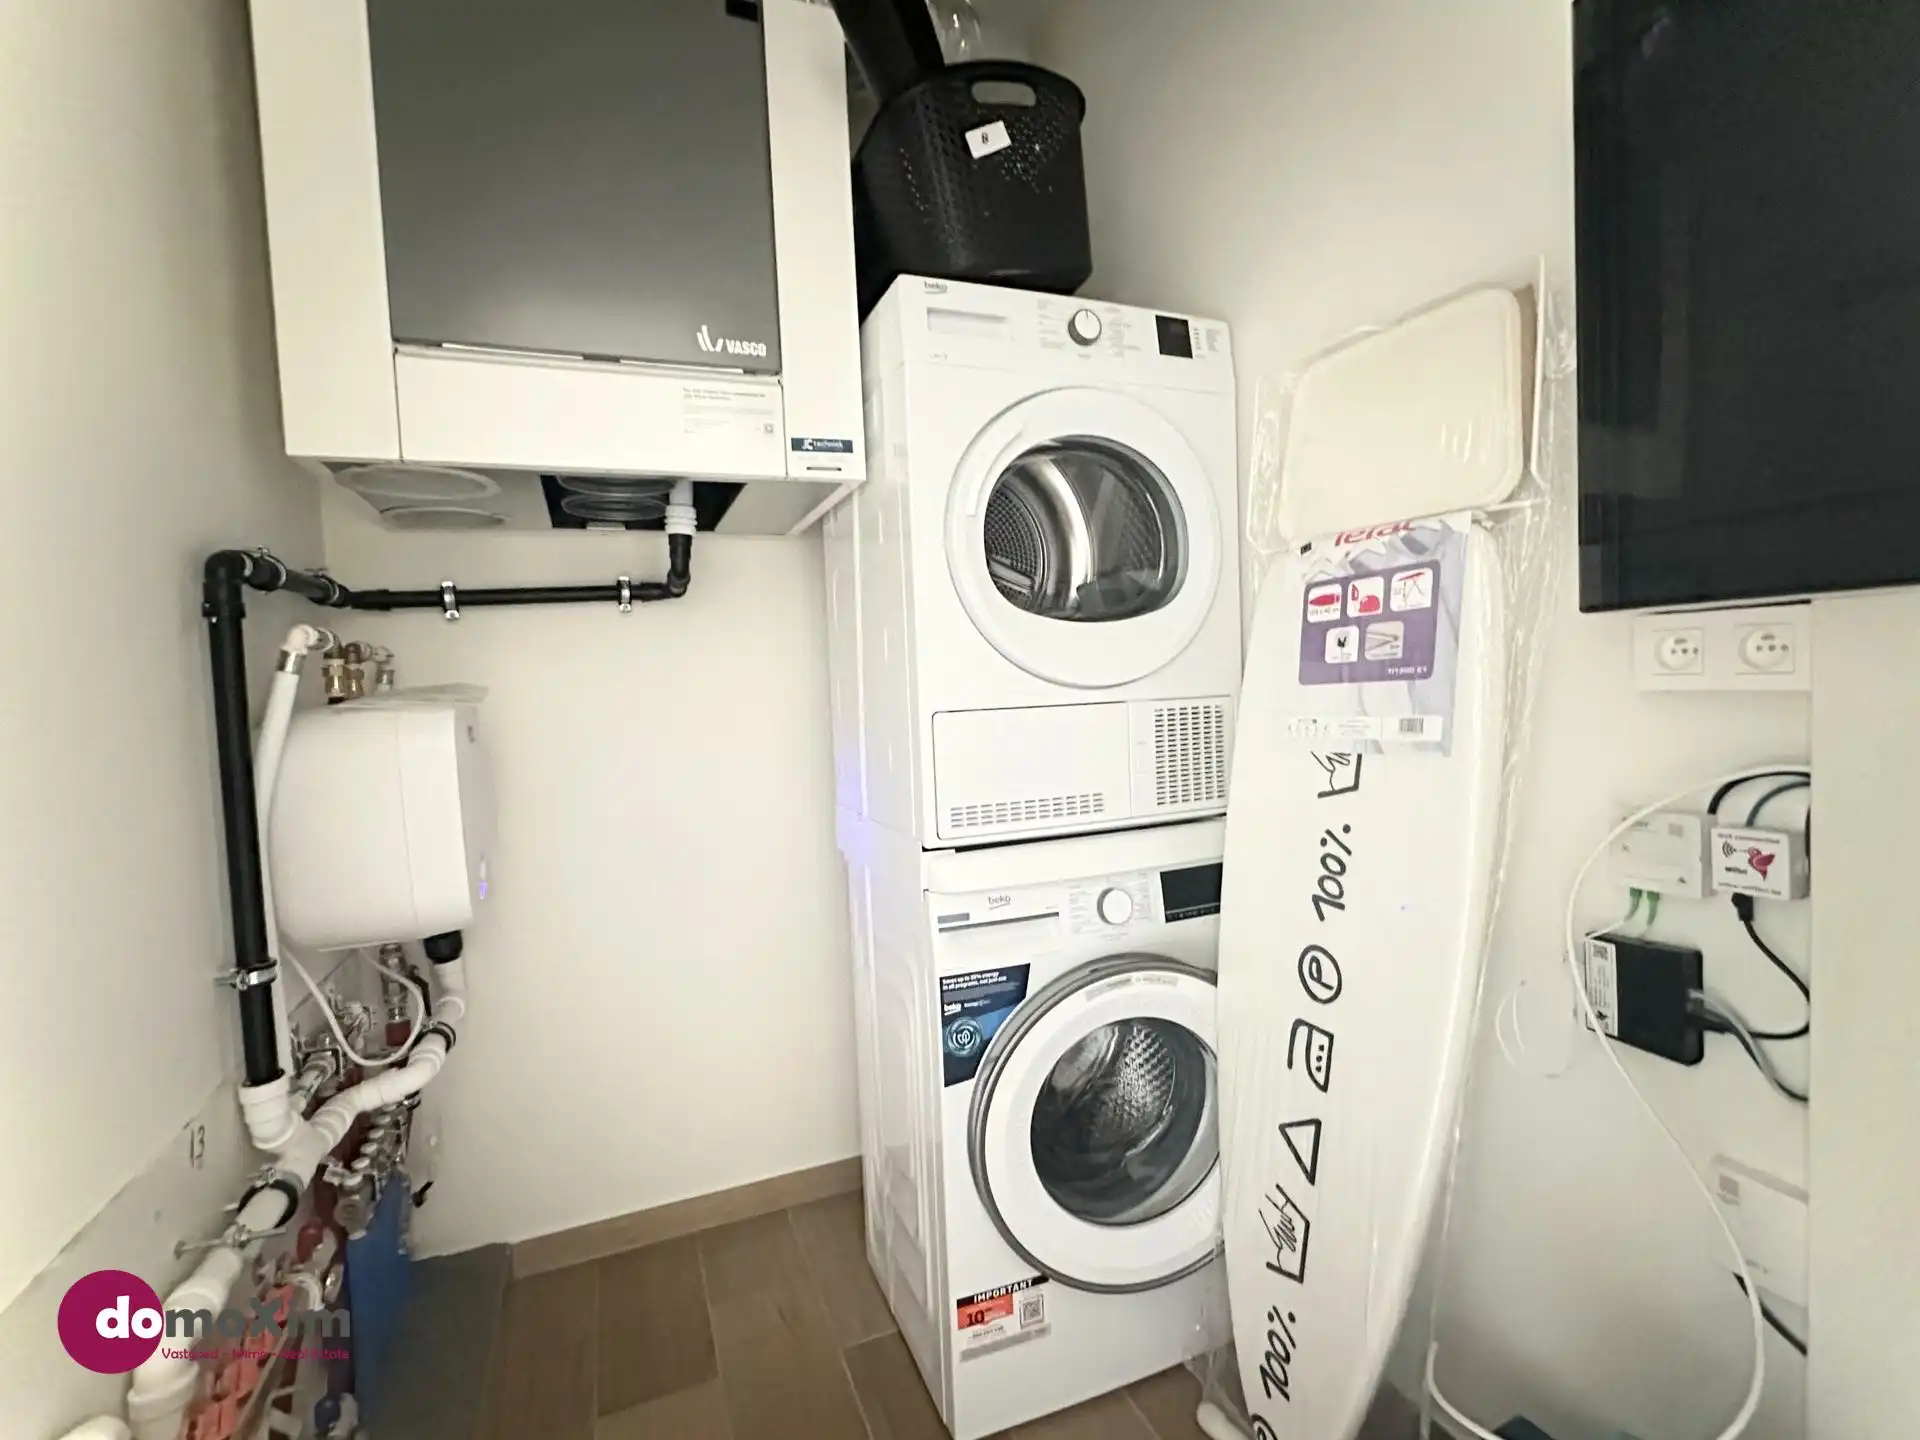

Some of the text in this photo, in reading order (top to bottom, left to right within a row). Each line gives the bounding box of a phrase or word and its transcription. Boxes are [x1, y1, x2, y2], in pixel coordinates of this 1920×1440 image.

[924, 281, 948, 293] beko
[725, 339, 767, 357] VASCO
[1312, 823, 1352, 922] 100%
[988, 895, 1011, 908] beko
[974, 1280, 1032, 1303] IMPORTANT
[967, 1310, 985, 1326] 10
[1260, 1305, 1296, 1402] 100%
